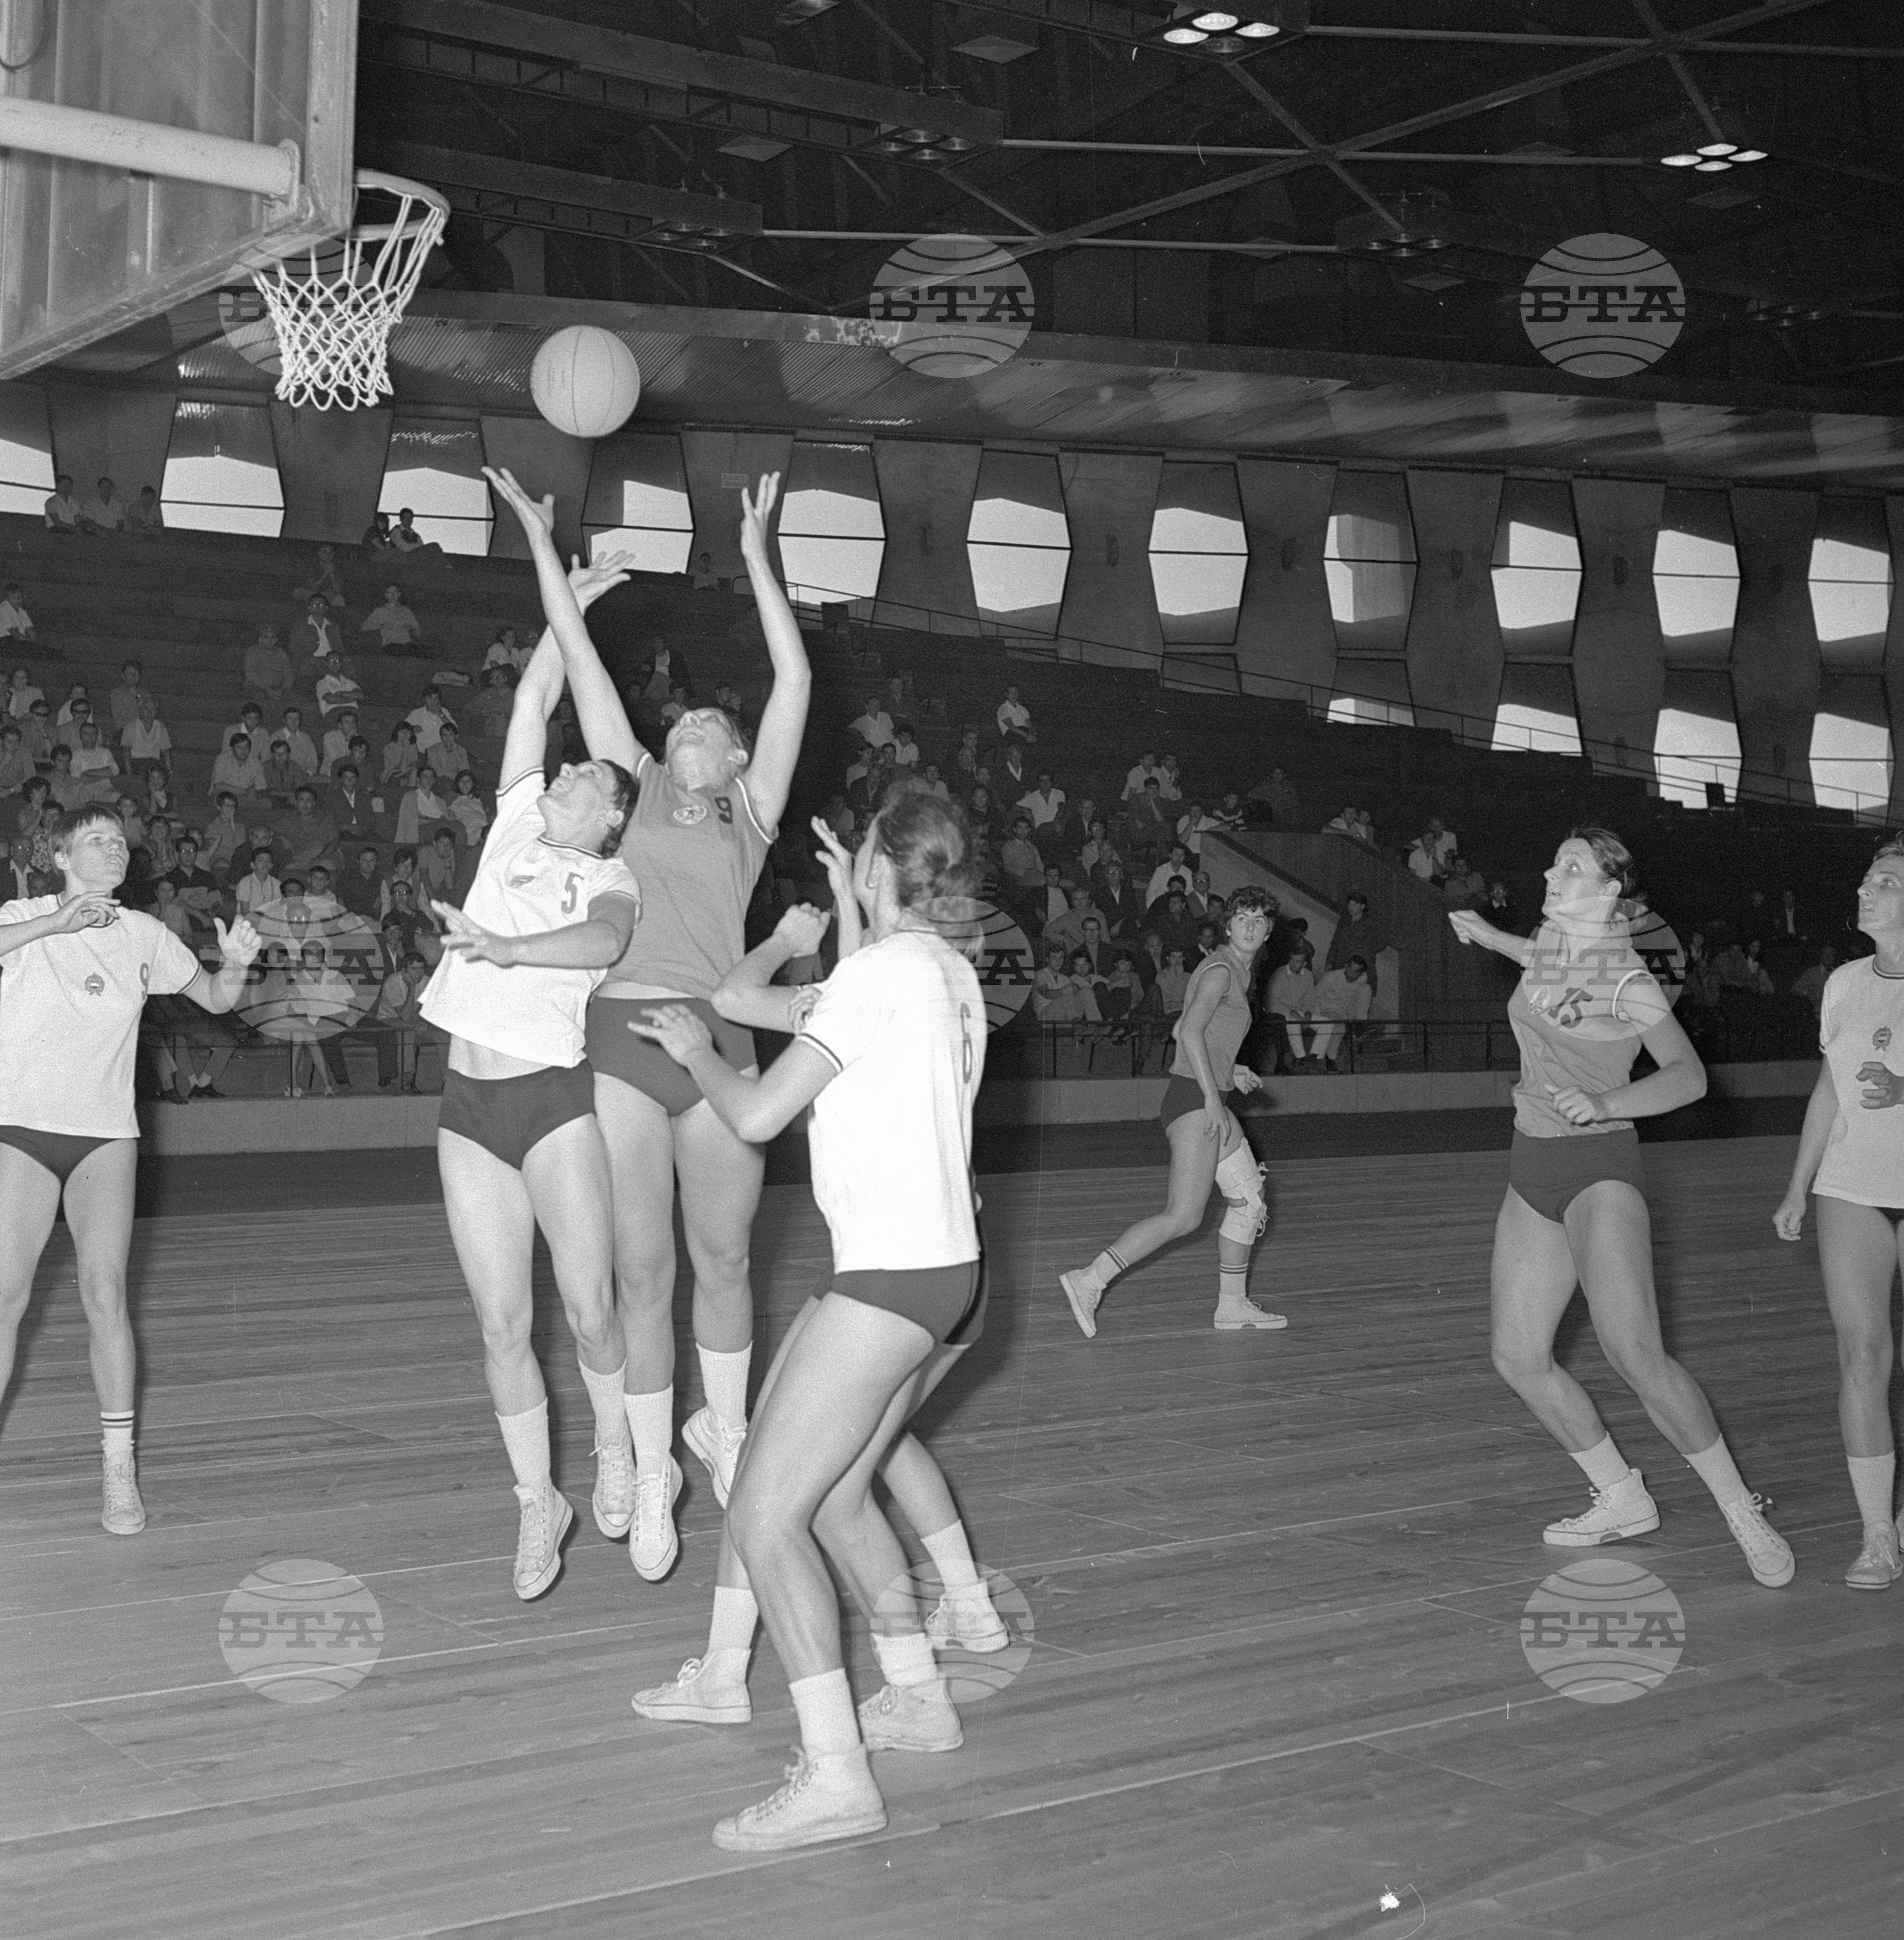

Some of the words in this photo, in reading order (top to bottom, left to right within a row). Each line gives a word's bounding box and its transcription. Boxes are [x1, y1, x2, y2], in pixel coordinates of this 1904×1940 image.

[715, 796, 733, 824] 9
[561, 872, 584, 914] 5
[1548, 987, 1594, 1029] 15
